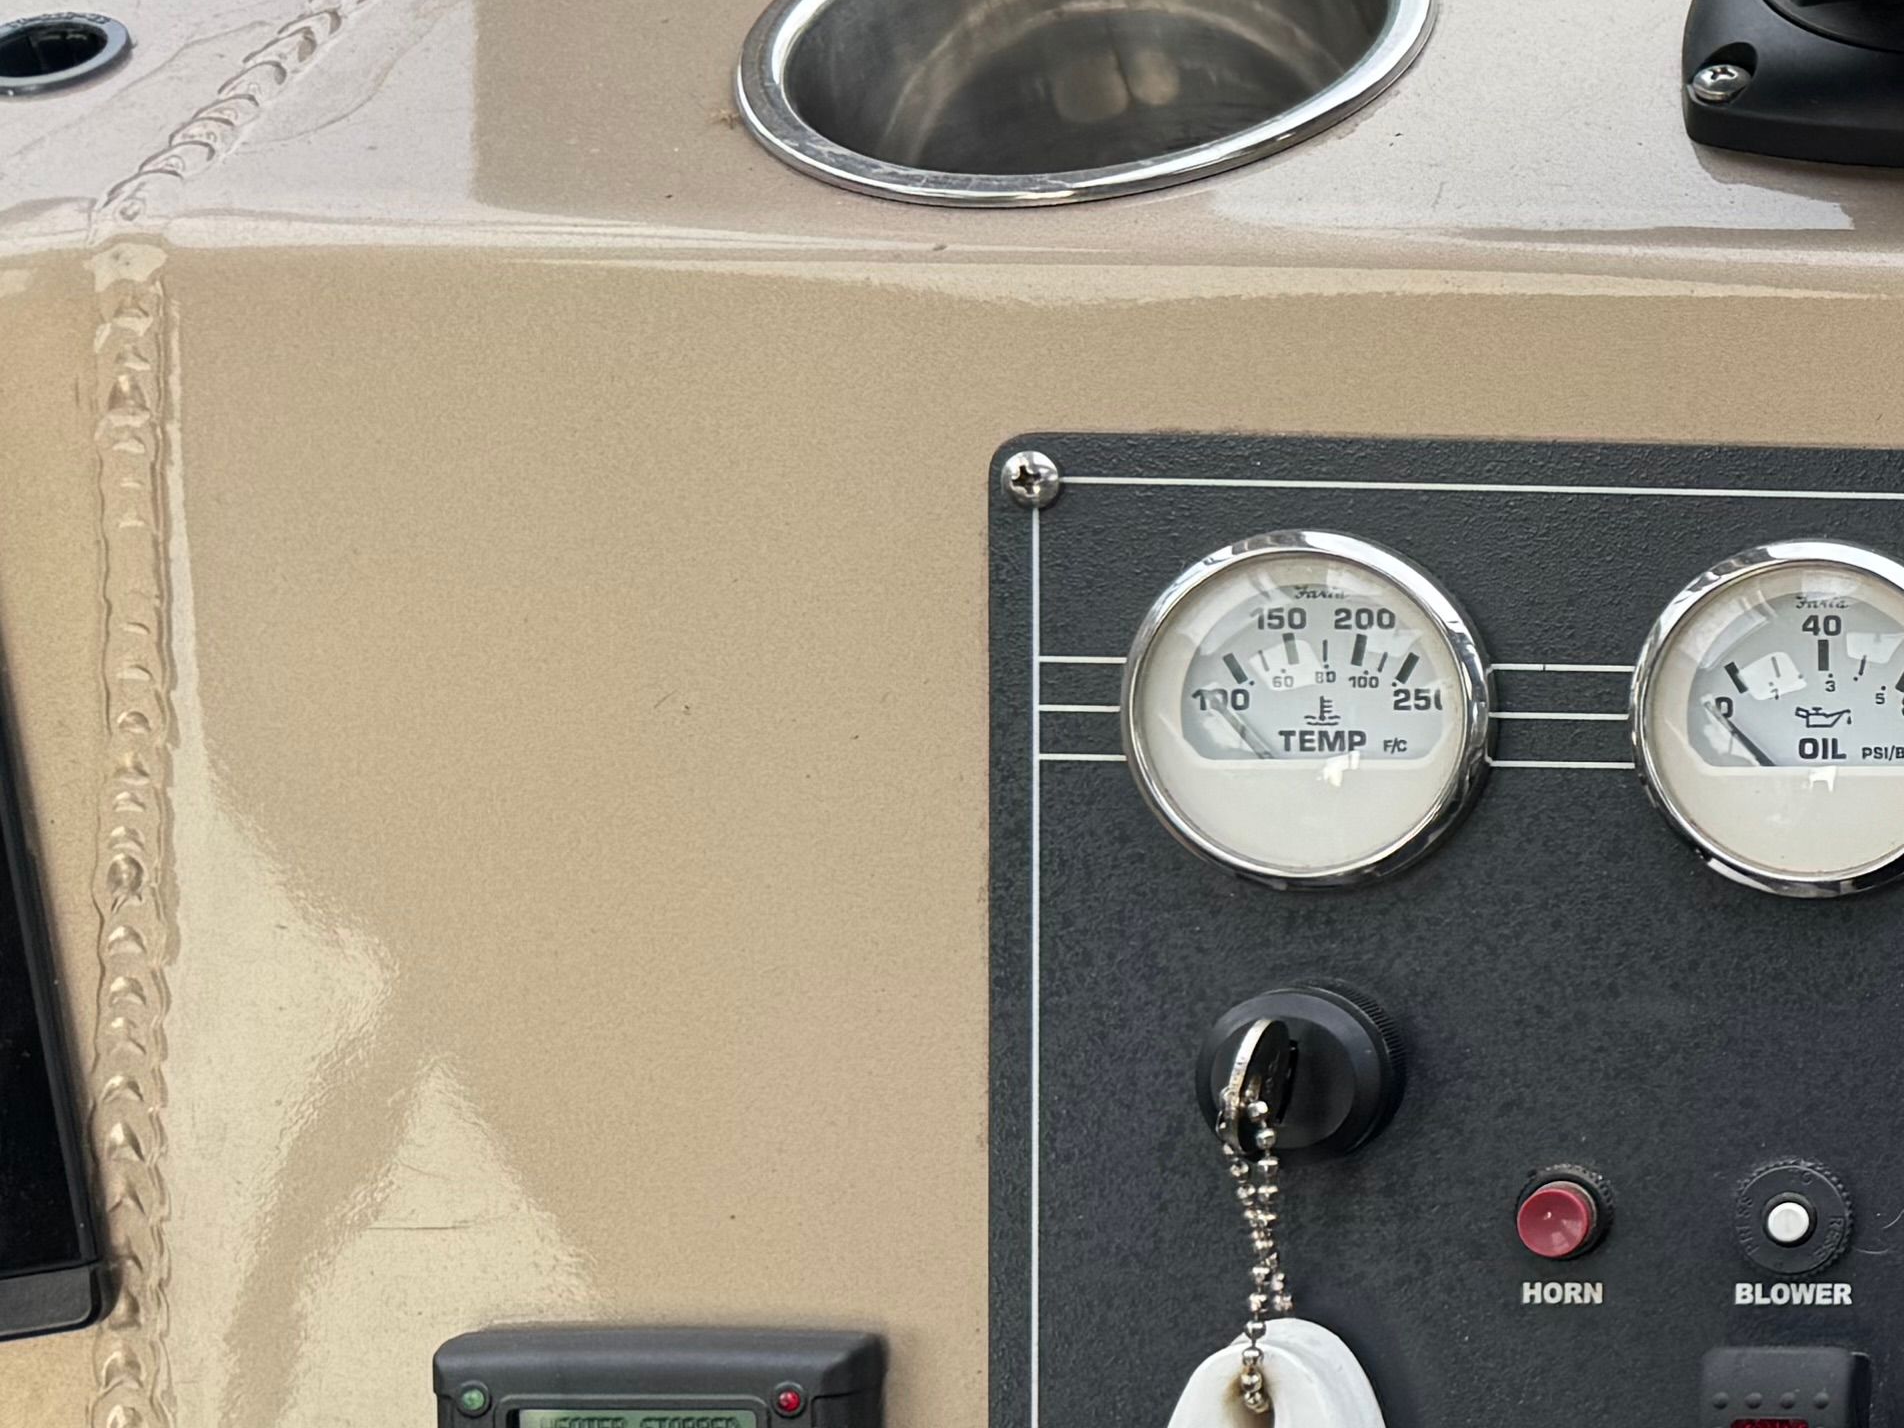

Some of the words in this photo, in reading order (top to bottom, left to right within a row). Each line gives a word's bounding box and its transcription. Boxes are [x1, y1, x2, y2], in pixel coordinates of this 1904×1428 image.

[1256, 607, 1307, 630] 150
[1334, 607, 1396, 630] 200
[1801, 615, 1842, 636] 40
[1272, 675, 1294, 688] 60
[1315, 671, 1336, 684] 80
[1348, 675, 1379, 689] 100
[1825, 680, 1836, 692] 3
[1875, 692, 1886, 705] 5
[1278, 730, 1366, 752] TEMP
[1383, 739, 1408, 754] F/C
[1798, 738, 1847, 760] OIL
[1522, 1282, 1603, 1304] HORN
[1735, 1283, 1852, 1305] BLOWER
